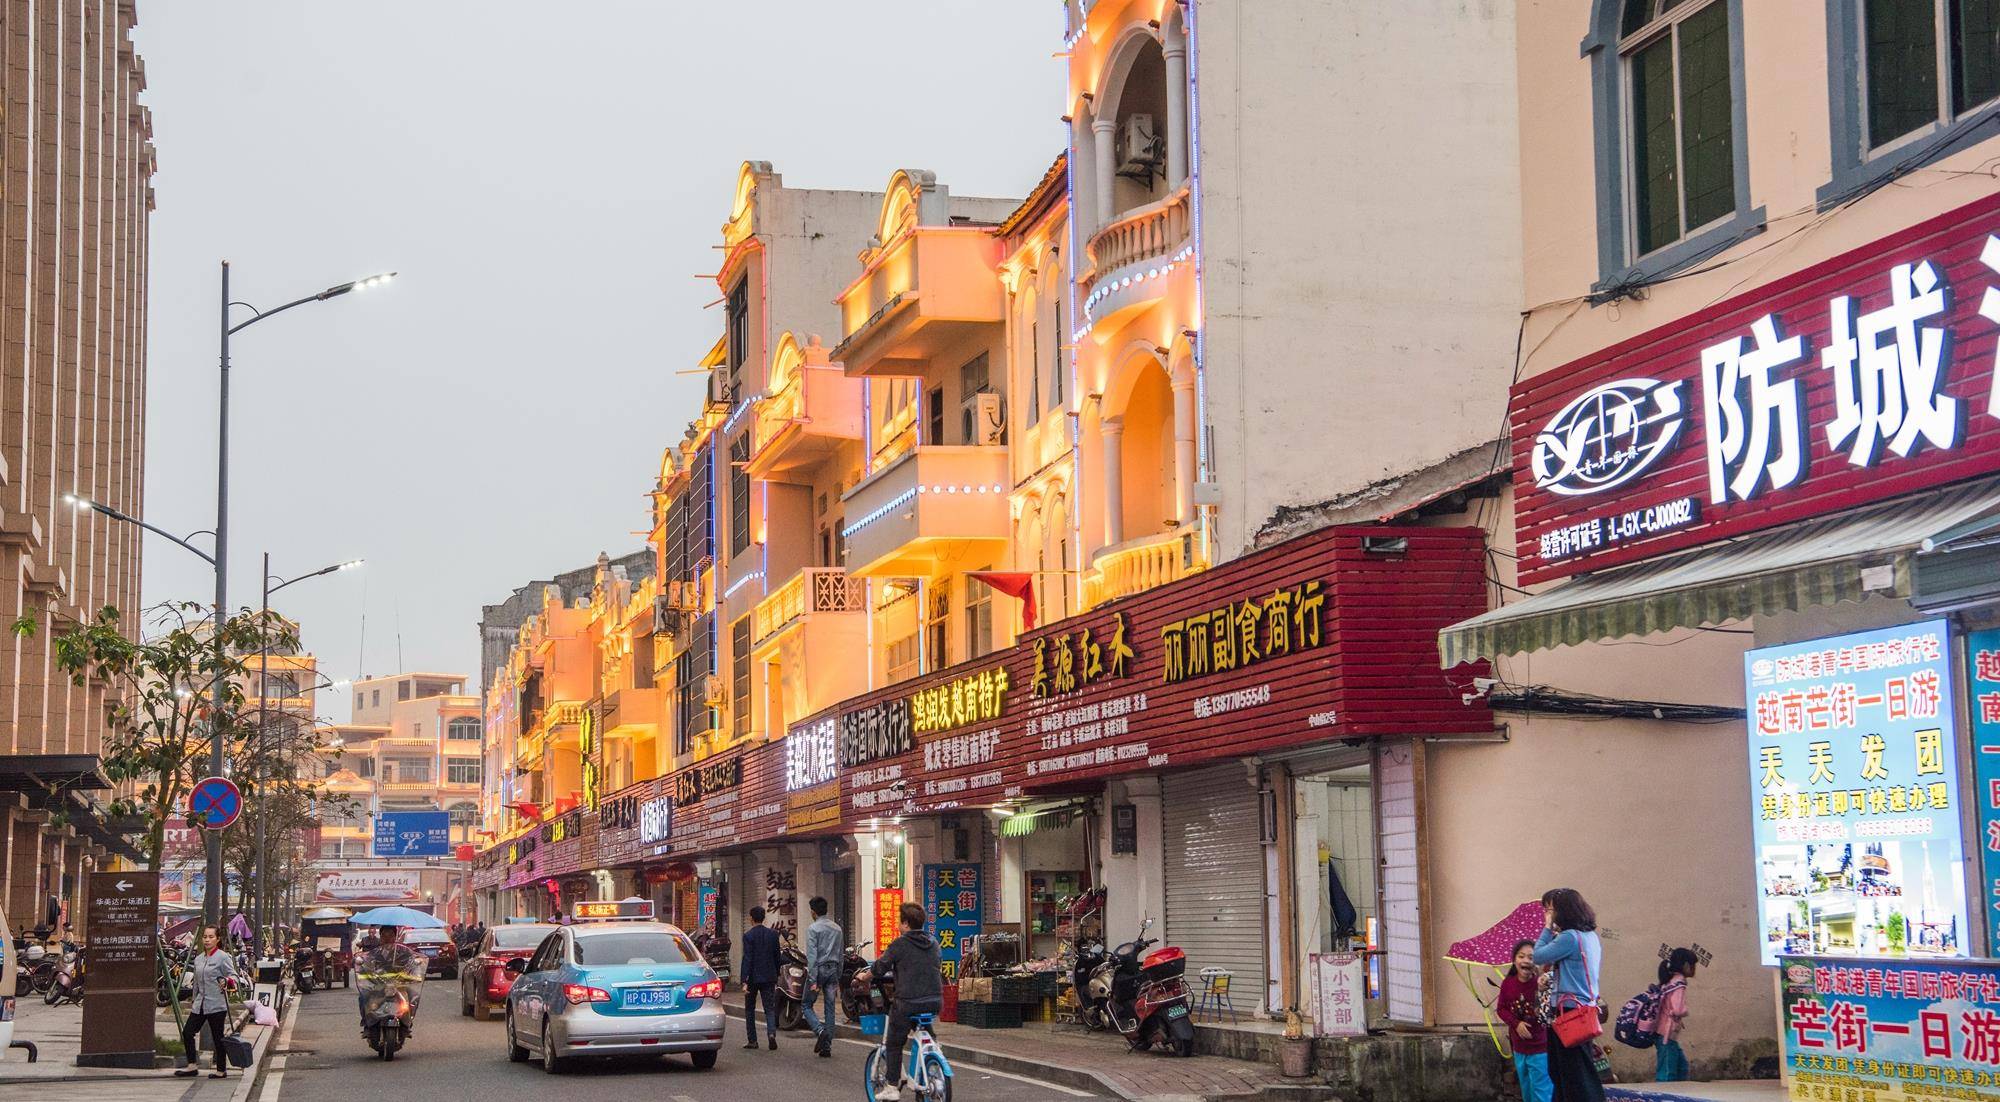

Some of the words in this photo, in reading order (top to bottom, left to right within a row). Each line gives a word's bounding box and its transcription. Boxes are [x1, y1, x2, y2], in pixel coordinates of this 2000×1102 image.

[1541, 518, 1602, 559] 经营许可证号
[1160, 581, 1325, 682] 丽丽副食商行
[1775, 633, 1940, 682] 防城港青年国际旅行社
[913, 671, 1009, 732] 鸿润发越南特产
[1756, 671, 1940, 736] 越南芒街一日游
[924, 727, 1001, 772] 批发零售越南特产
[1760, 728, 1944, 788] 天天发团
[1761, 782, 1950, 821] 凭身份证即可快速办理
[96, 897, 151, 906] 华美达广场酒店
[958, 868, 977, 968] 芒街一日
[94, 936, 149, 944] 维也纳国际酒店
[1332, 970, 1352, 1024] 小卖部
[1815, 966, 2000, 1003] 防城港青年国际旅行社
[1790, 997, 2000, 1066] 芒街一日游
[1795, 1052, 1848, 1072] 天天发团
